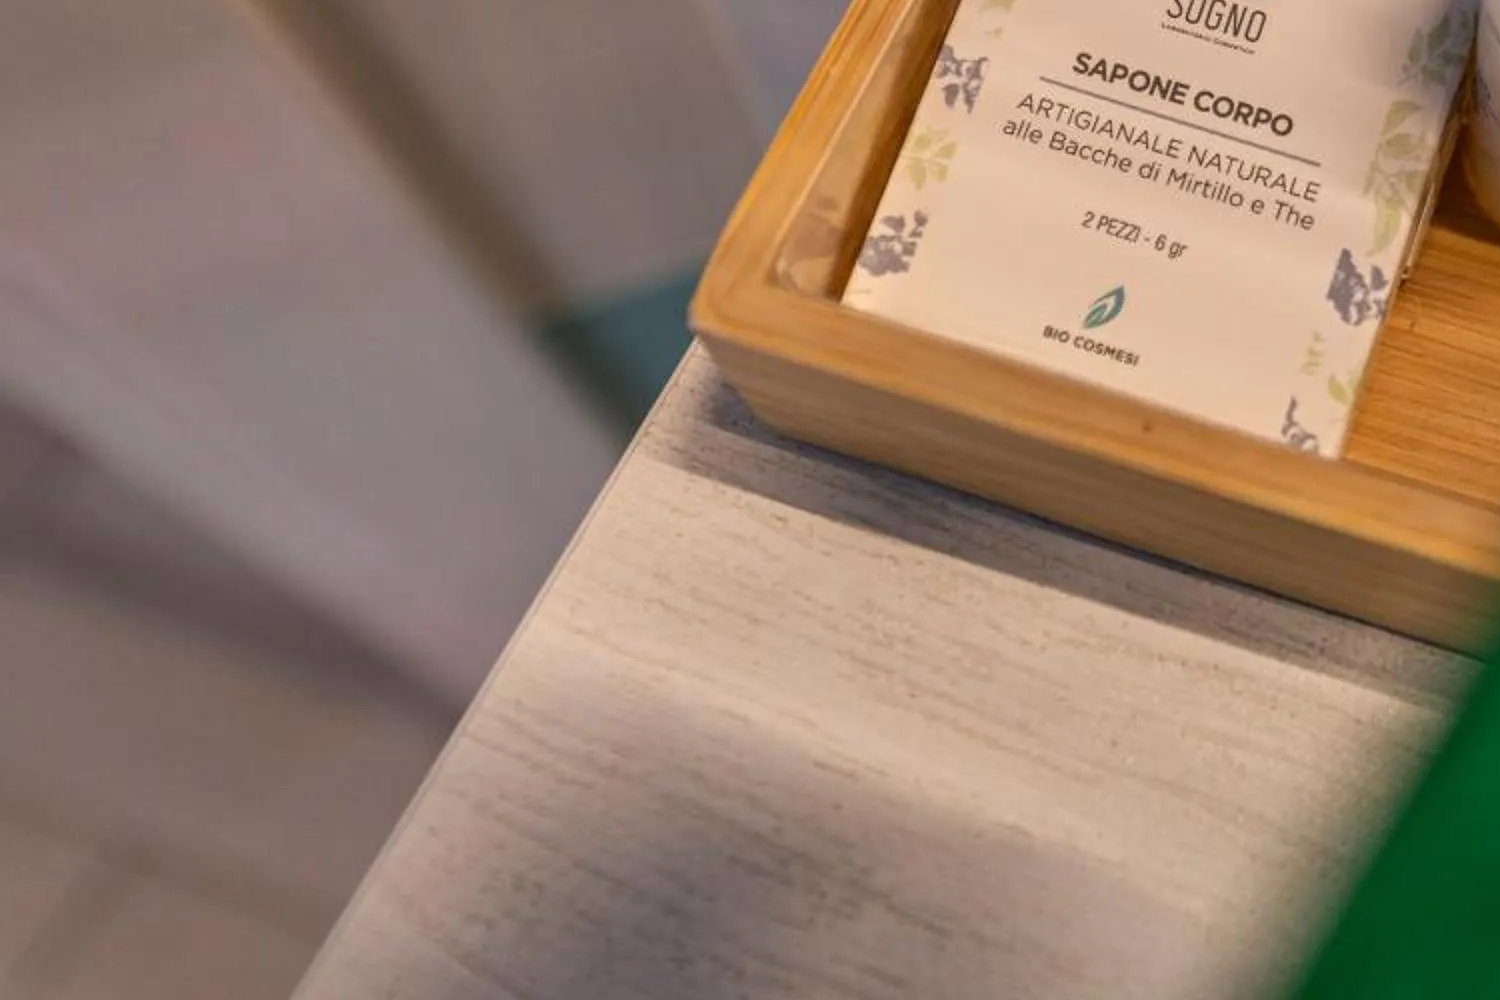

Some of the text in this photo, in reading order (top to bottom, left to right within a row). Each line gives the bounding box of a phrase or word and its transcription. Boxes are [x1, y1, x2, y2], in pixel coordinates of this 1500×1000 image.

[1072, 52, 1294, 136] SAPONE CORPO
[1002, 119, 1316, 230] alle Bacche di Mirtillo e The
[1016, 93, 1321, 203] ARTIGIANALE NATURALE
[1082, 211, 1095, 228] 2
[1096, 215, 1142, 244] PEZZI
[1154, 233, 1167, 251] 6
[1167, 241, 1188, 259] gr
[1043, 325, 1140, 366] BIO COSMESI
